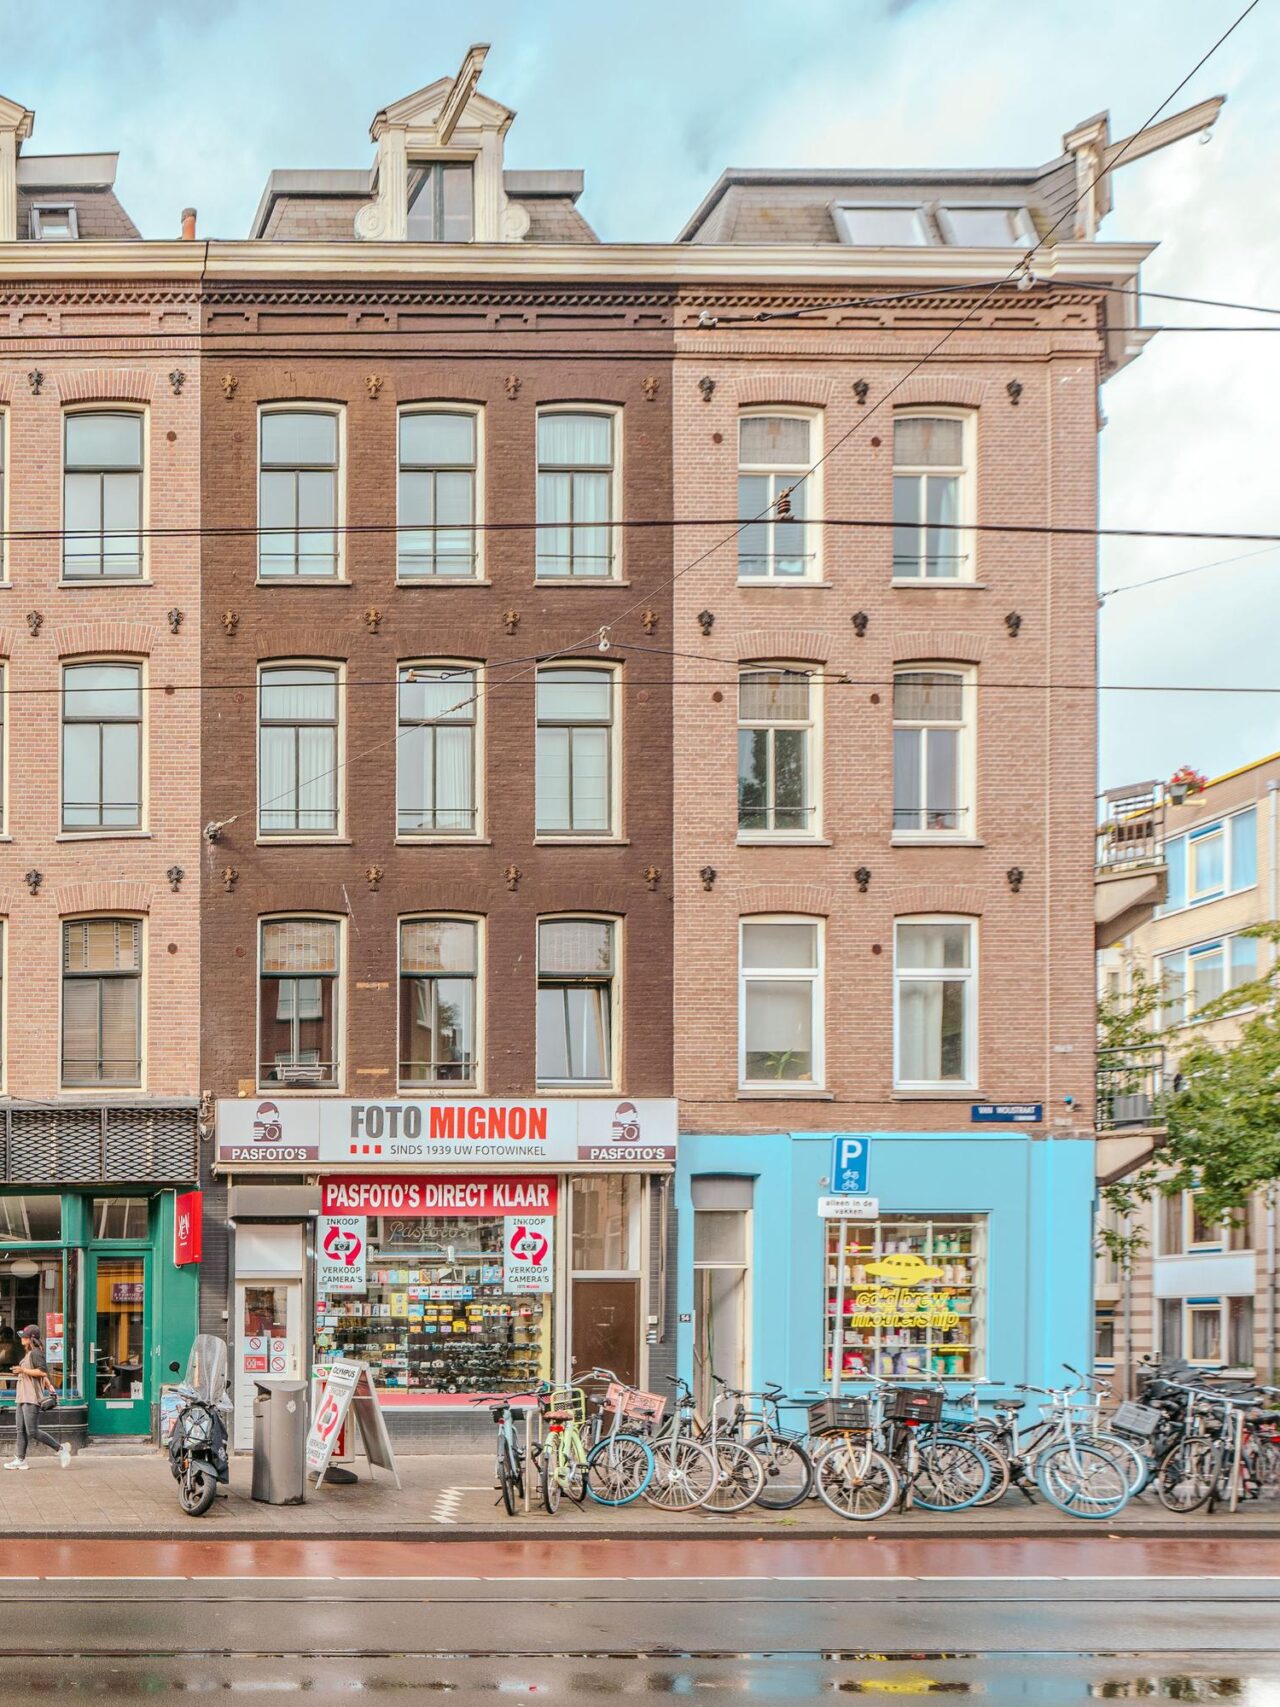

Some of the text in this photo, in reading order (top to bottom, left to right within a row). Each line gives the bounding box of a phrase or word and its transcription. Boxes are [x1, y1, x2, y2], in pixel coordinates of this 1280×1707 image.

[350, 1105, 547, 1140] FOTO MIGNON
[231, 1148, 307, 1160] PASFOTO'S
[390, 1144, 547, 1156] SINDS 1939 UW FOTOWINKEL
[590, 1148, 666, 1160] PASFOTO'S
[841, 1140, 863, 1169] P
[326, 1183, 549, 1208] PASFOTO'S DIRECT KLAAR
[326, 1218, 359, 1226] INKOOP
[513, 1218, 546, 1226] INKOOP
[322, 1266, 361, 1274] VERKOOP
[509, 1266, 548, 1274] VERKOOP
[322, 1275, 363, 1283] CAMERA'S
[508, 1275, 549, 1283] CAMERA'S
[900, 1288, 949, 1308] brew
[851, 1308, 960, 1332] mothership
[332, 1366, 356, 1378] OLYMPUS
